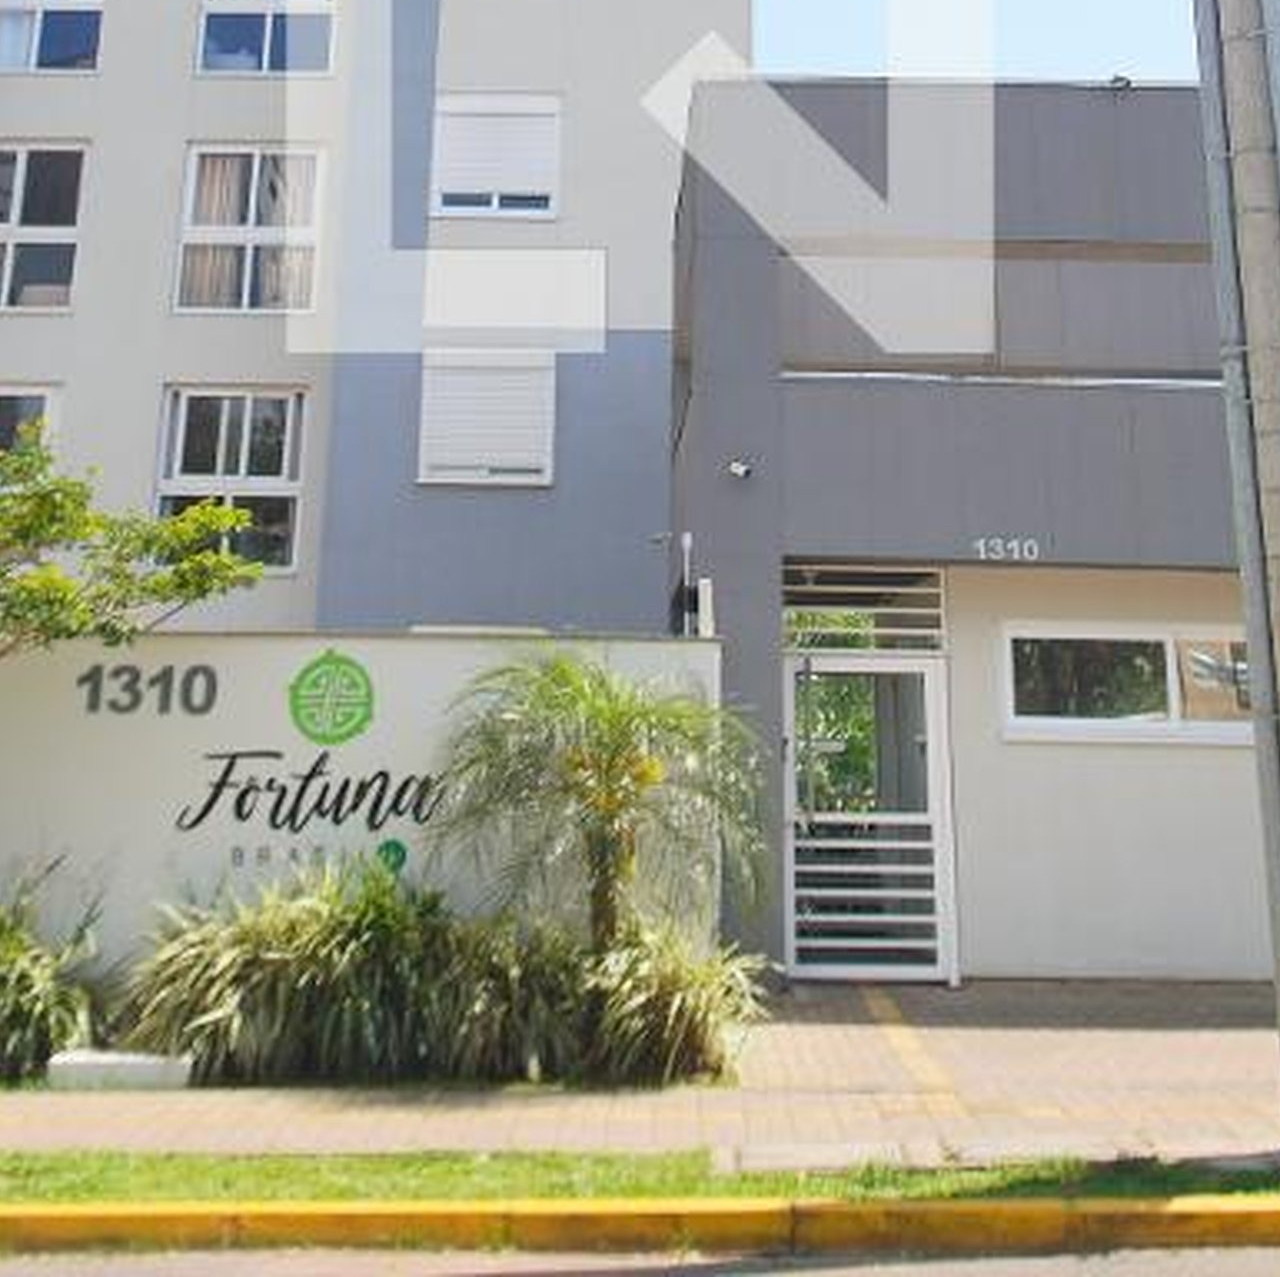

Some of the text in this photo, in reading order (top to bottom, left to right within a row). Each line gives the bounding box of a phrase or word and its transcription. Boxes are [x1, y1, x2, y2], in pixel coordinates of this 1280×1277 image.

[973, 537, 1039, 560] 1310
[76, 664, 218, 715] 1310
[176, 751, 447, 833] Fortuna
